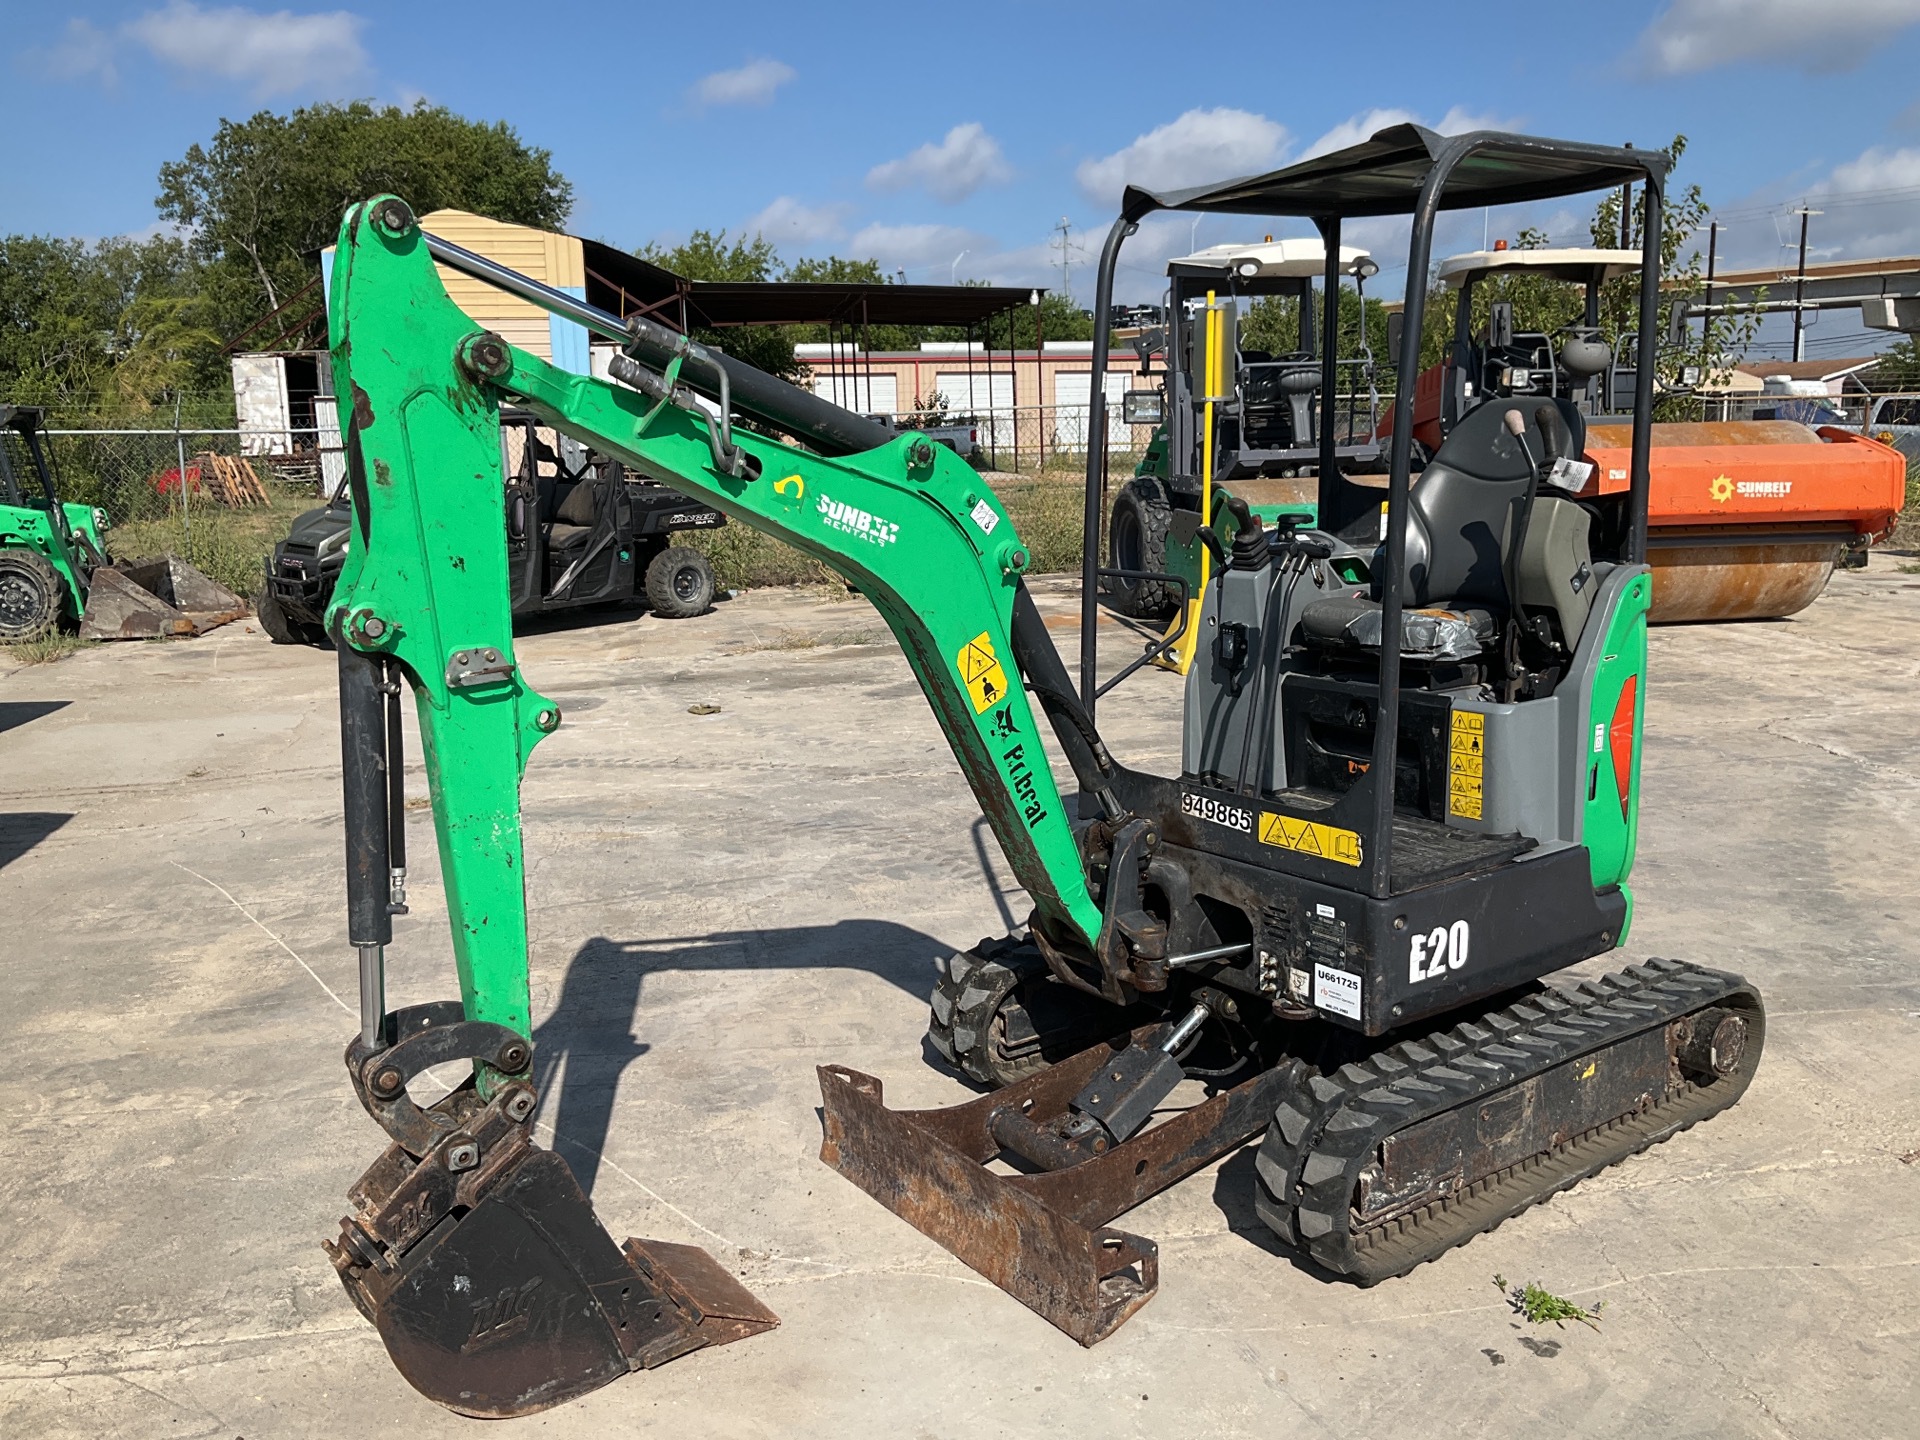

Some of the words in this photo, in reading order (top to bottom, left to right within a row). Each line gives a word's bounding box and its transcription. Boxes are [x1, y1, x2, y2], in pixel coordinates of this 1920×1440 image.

[1736, 481, 1792, 494] SUNBELT
[823, 517, 885, 547] RENTALS
[1182, 794, 1251, 831] 949865
[1409, 919, 1469, 984] E20
[1318, 969, 1358, 991] U661725
